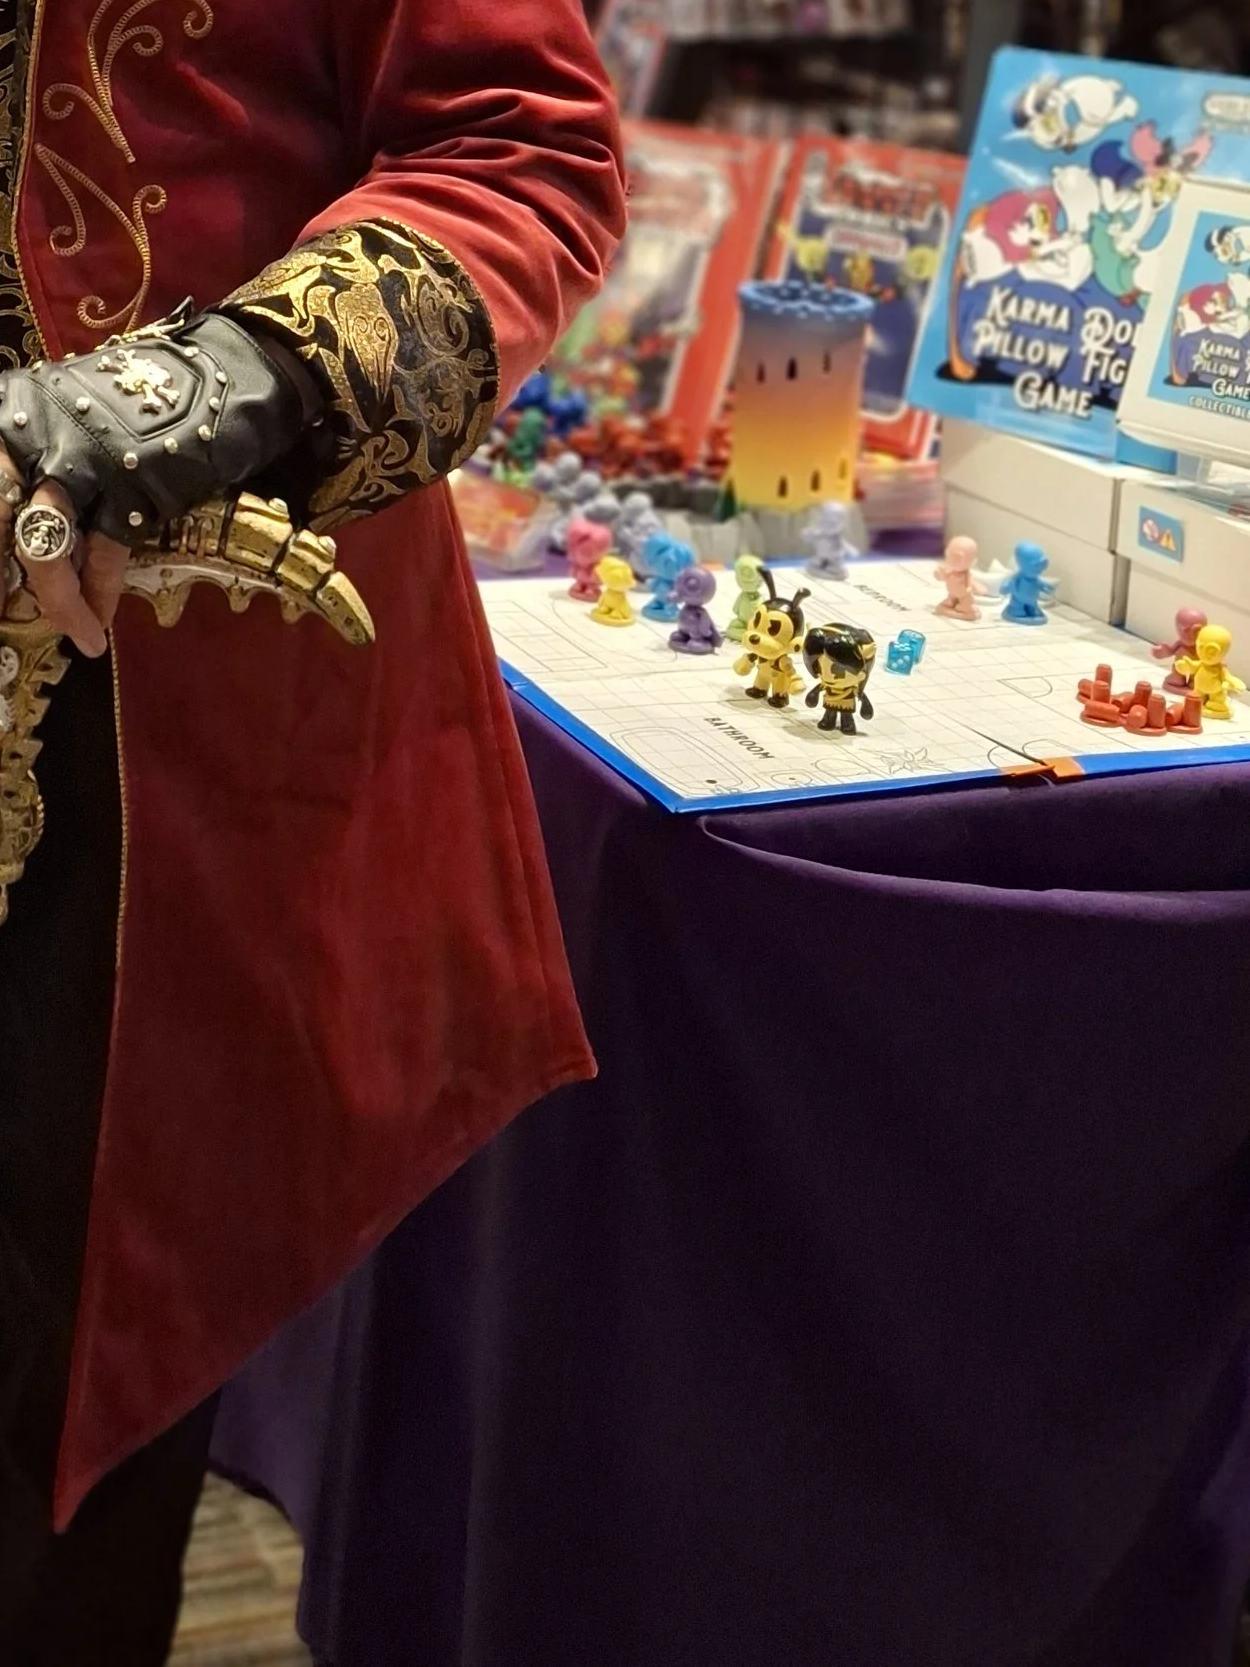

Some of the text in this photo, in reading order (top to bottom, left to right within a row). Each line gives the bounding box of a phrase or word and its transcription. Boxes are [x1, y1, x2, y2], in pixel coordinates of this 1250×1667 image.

[985, 285, 1071, 332] KARMA
[972, 319, 1128, 384] PILLOW FIG
[1013, 371, 1094, 420] GAME
[703, 717, 776, 760] BATHROOM
